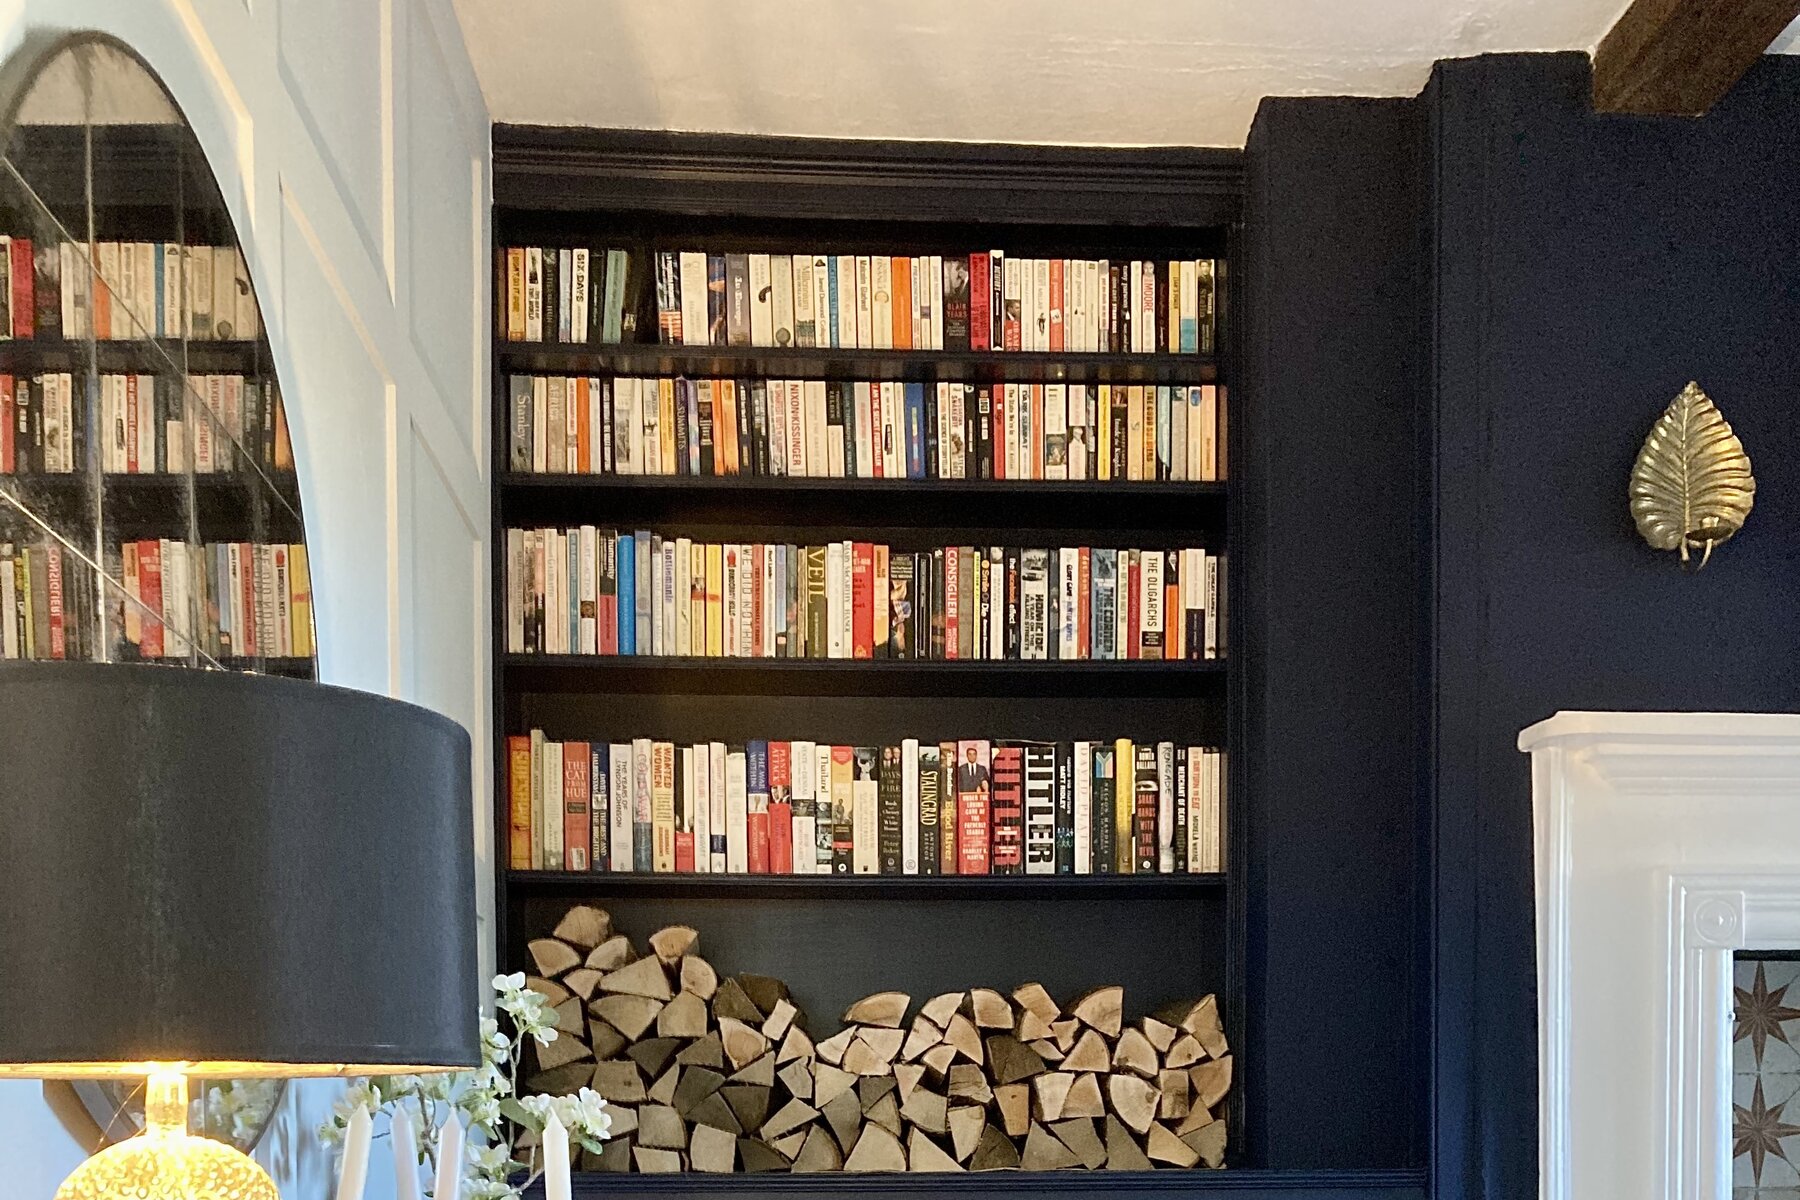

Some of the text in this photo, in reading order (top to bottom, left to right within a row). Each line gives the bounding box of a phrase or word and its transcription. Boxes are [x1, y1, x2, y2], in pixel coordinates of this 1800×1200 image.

[577, 254, 585, 272] SIX
[576, 275, 584, 302] DAYS
[802, 266, 810, 310] Millennium
[1144, 283, 1153, 313] MOORE
[549, 384, 558, 420] AFRICA
[873, 389, 879, 398] AM
[513, 395, 530, 440] Stanley
[677, 406, 686, 450] SUMMITS
[790, 384, 801, 466] NIXON KISSINGER
[1113, 448, 1121, 477] Kingdom
[742, 548, 751, 595] WE DID
[808, 549, 825, 604] VEIL
[947, 550, 957, 618] CONSIGLIERI
[1147, 558, 1158, 627] THE OLIGARCHS
[1031, 622, 1034, 632] ON
[1035, 594, 1043, 652] HOMICIDE
[1104, 587, 1113, 653] THE CORNER
[565, 770, 586, 780] CAT
[566, 761, 587, 770] THE
[654, 748, 662, 788] WOMEN
[663, 748, 671, 789] WANTED
[780, 770, 786, 779] OF
[820, 754, 828, 793] Thailand
[1136, 761, 1157, 770] DALLAIRE
[1162, 747, 1173, 797] RENEGADE
[566, 787, 587, 798] HUE
[623, 800, 627, 810] OF
[920, 770, 938, 825] STALINGRAD
[994, 748, 1021, 866] HITLER
[1028, 748, 1053, 863] HITLER
[1138, 794, 1155, 804] SHAKE
[1192, 797, 1200, 810] EAT
[945, 801, 953, 830] Blood
[1137, 807, 1155, 817] HANDS
[1140, 820, 1154, 831] WITH
[1139, 846, 1154, 856] DEVIL
[1142, 833, 1152, 843] THE
